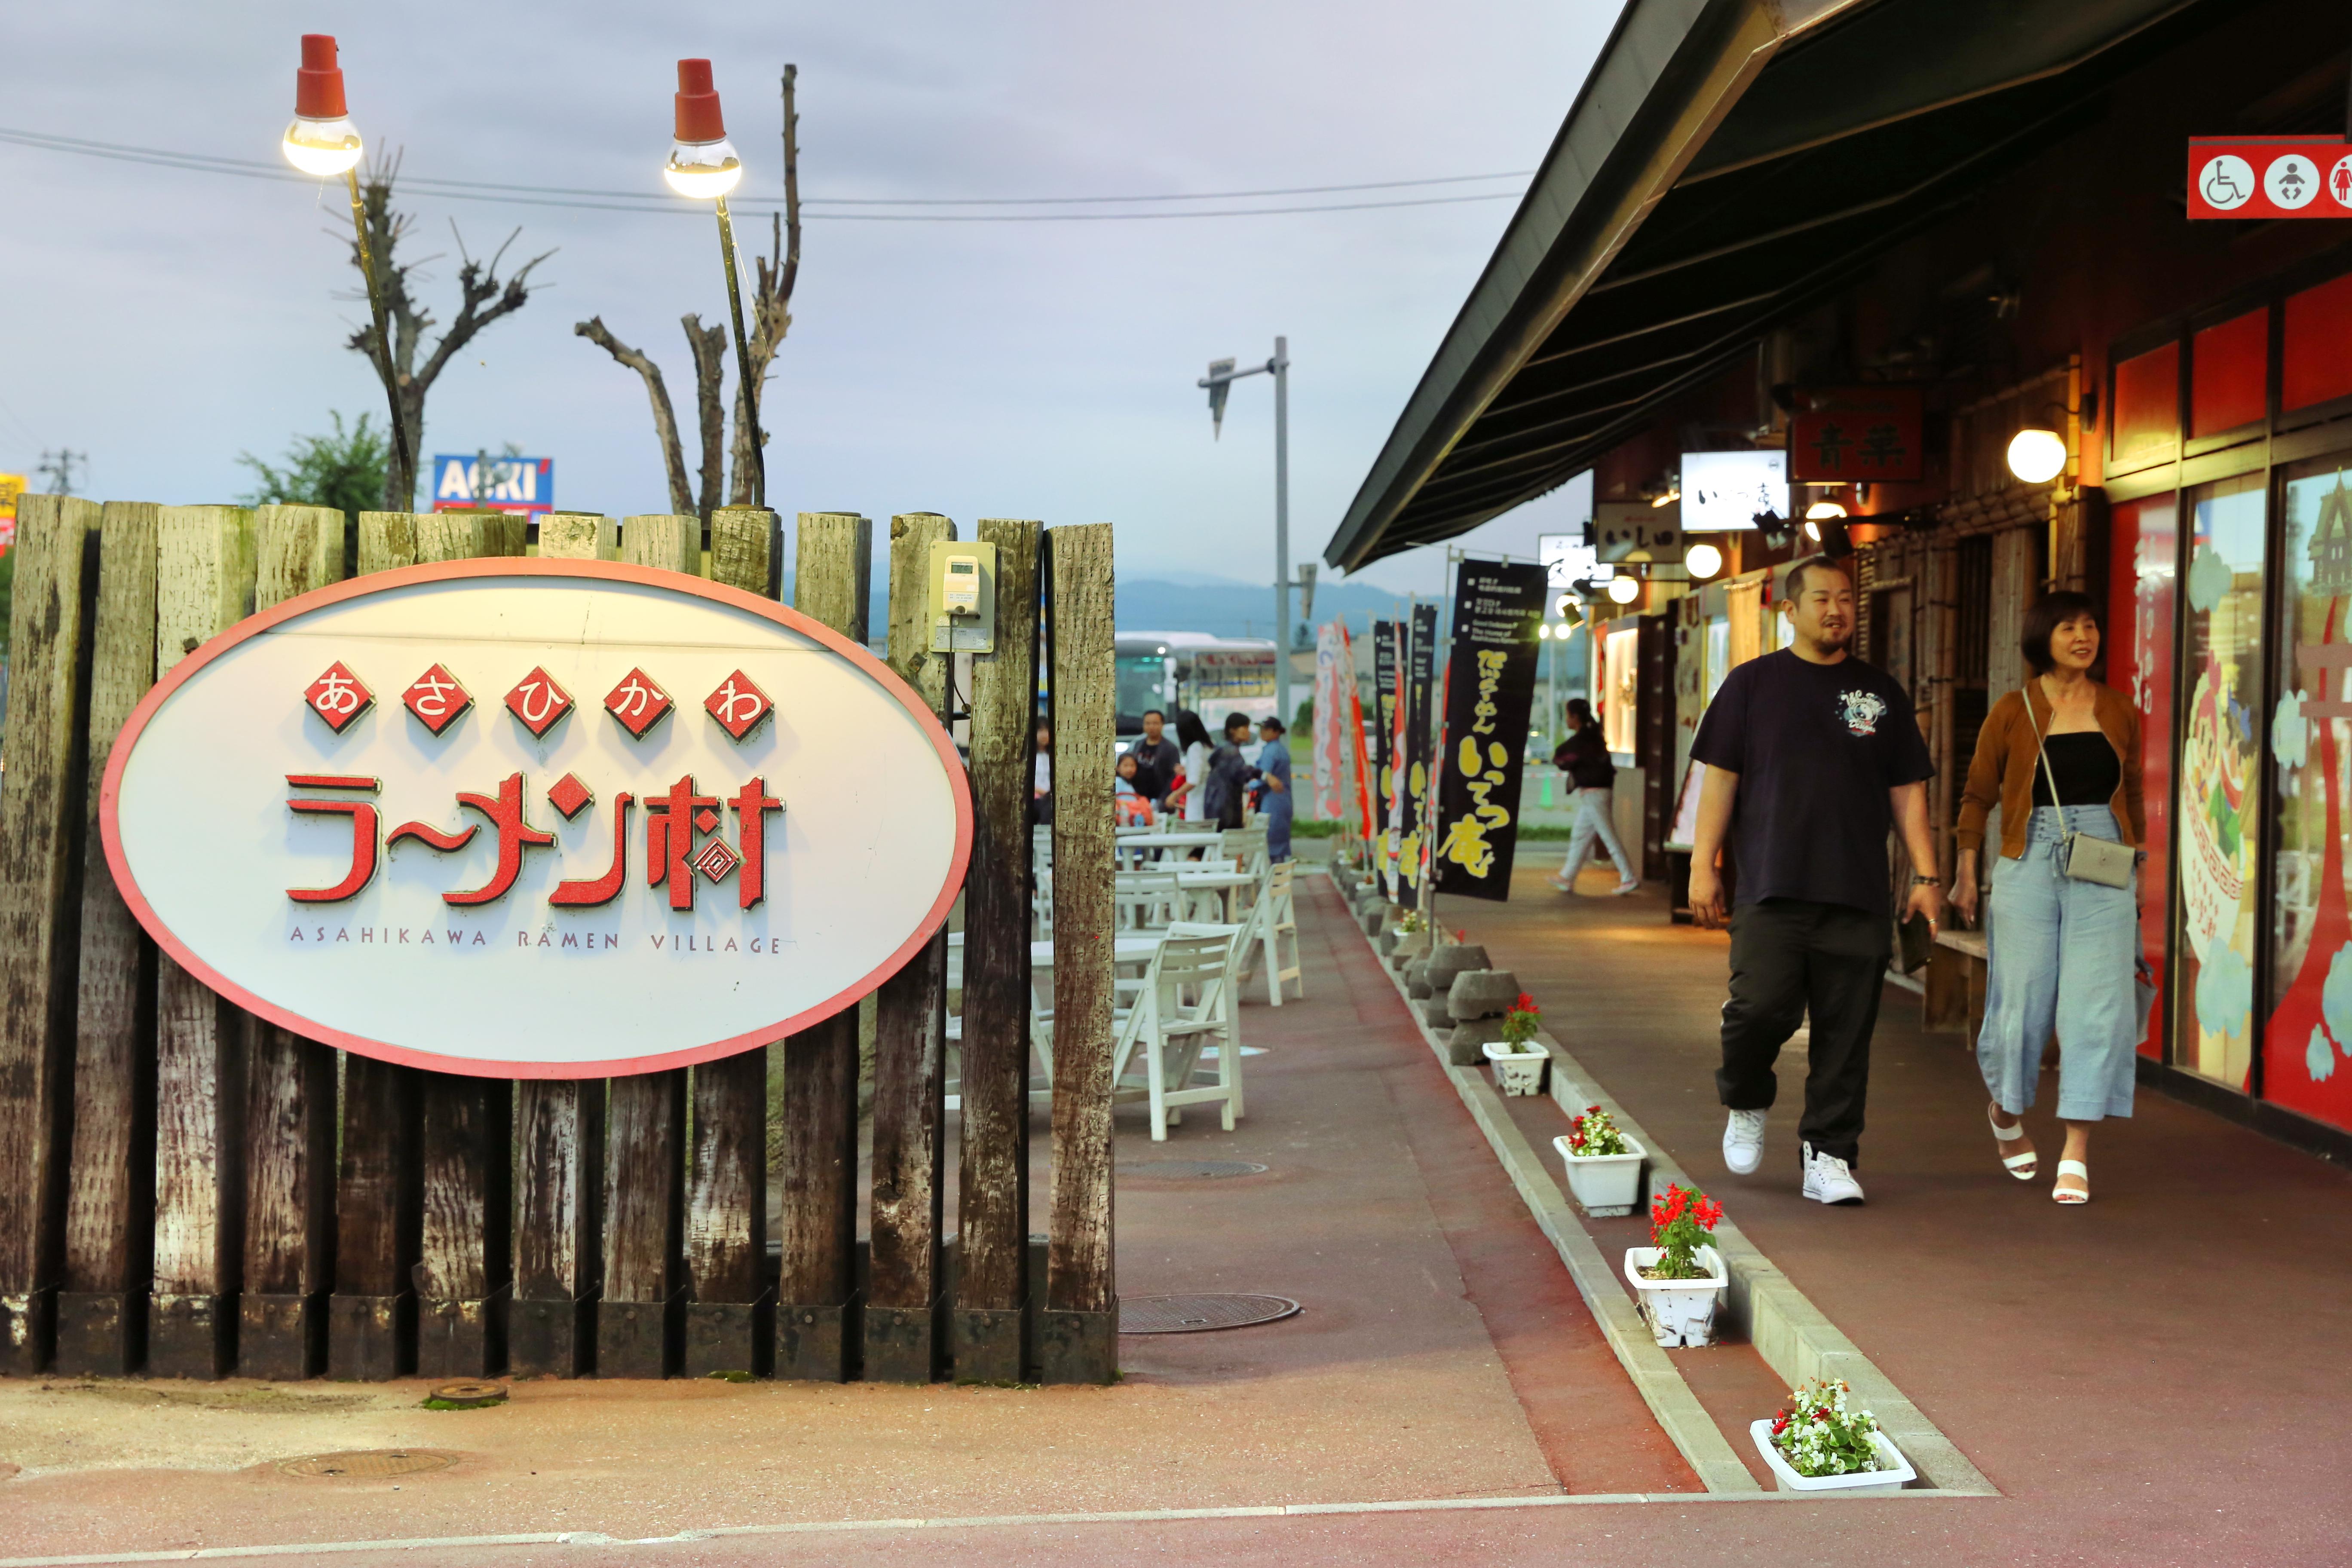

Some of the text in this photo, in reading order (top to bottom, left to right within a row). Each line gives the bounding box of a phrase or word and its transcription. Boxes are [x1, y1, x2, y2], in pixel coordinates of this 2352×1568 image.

[1810, 422, 1907, 472] 青葉
[315, 671, 762, 722] あさひかわ
[1436, 735, 1510, 878] いってつ庵
[285, 770, 787, 911] ラーメン村
[290, 926, 779, 954] ASAHIKAWA RAMEN VILLAGE
